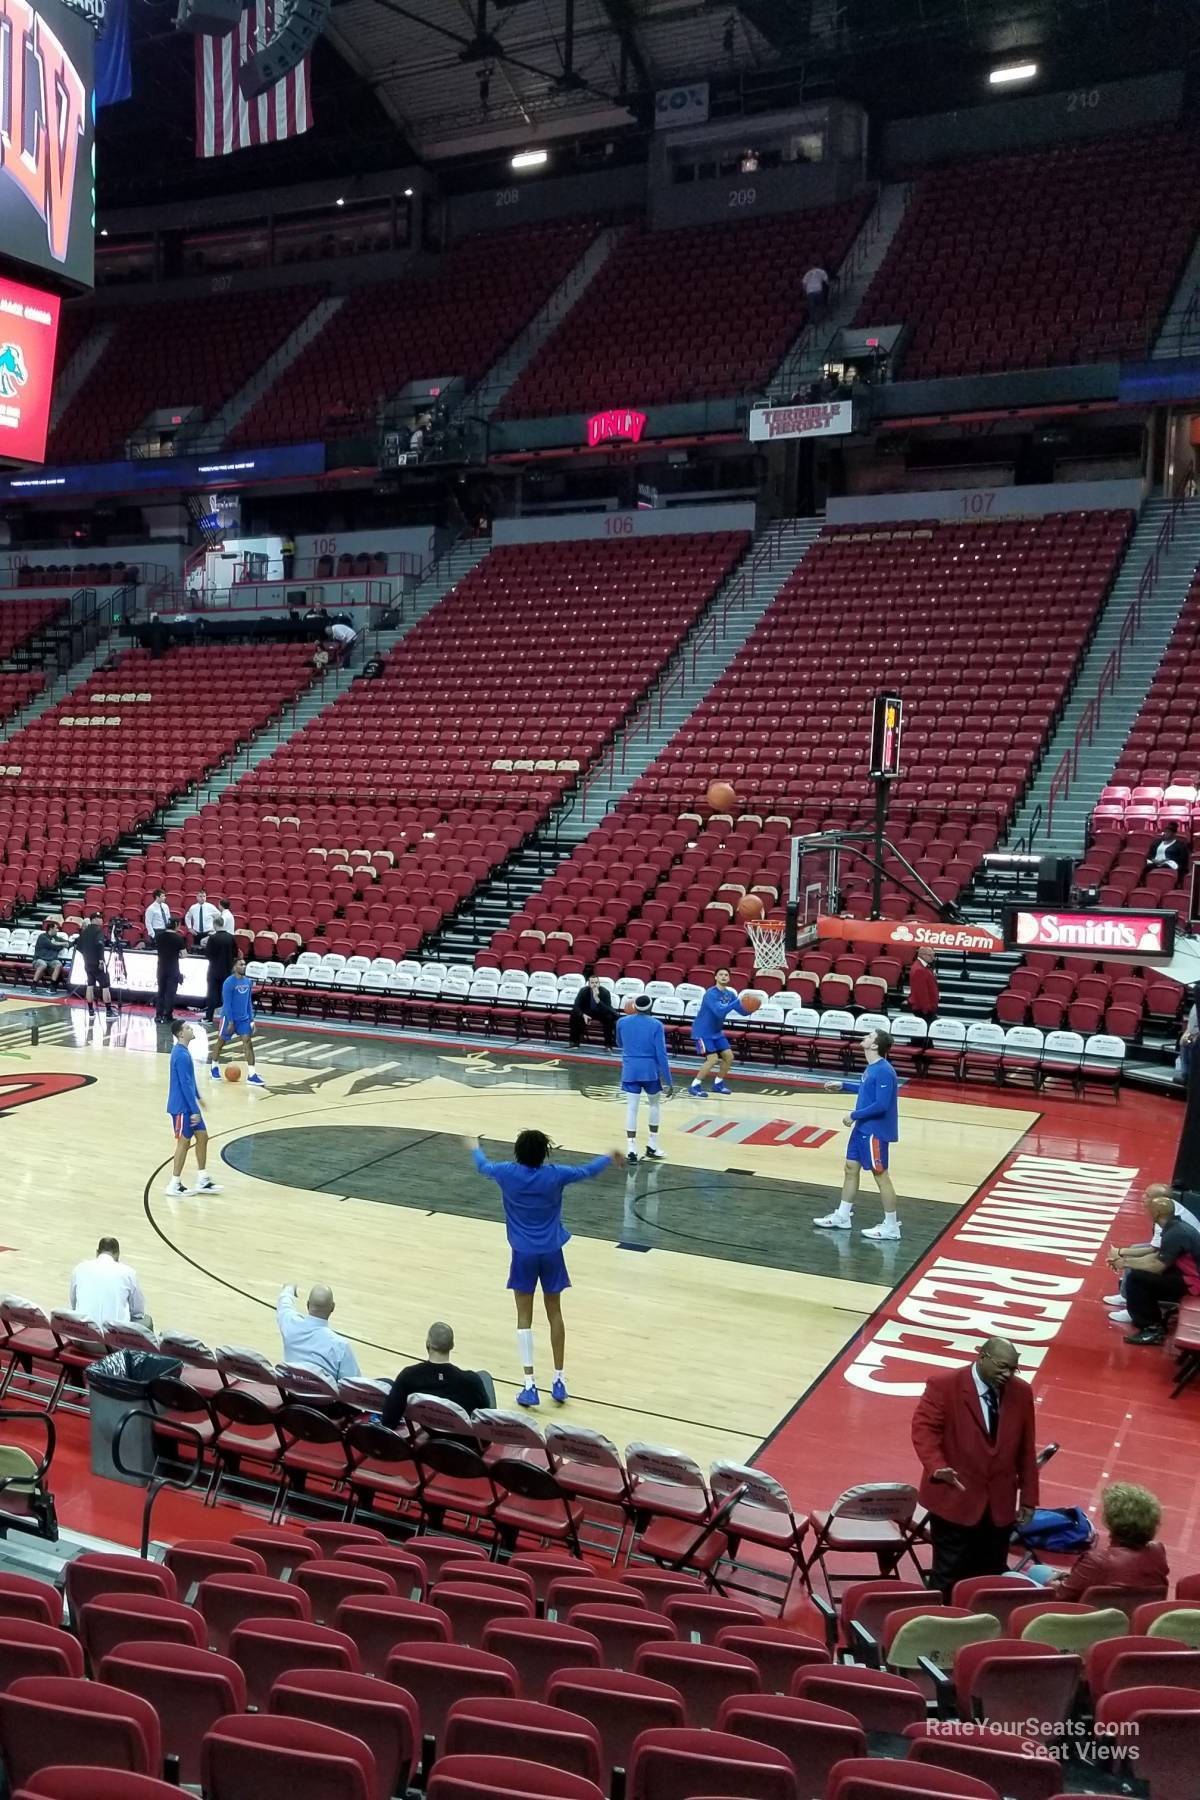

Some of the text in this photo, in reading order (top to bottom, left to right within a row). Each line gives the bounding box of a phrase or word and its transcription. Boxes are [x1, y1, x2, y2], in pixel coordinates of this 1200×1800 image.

[728, 187, 757, 207] 209
[587, 408, 647, 447] UNLV
[960, 493, 996, 513] 107
[604, 517, 633, 535] 106
[313, 537, 337, 555] 105
[1040, 915, 1137, 948] Smith's
[954, 1154, 1140, 1266] RUNNIN'
